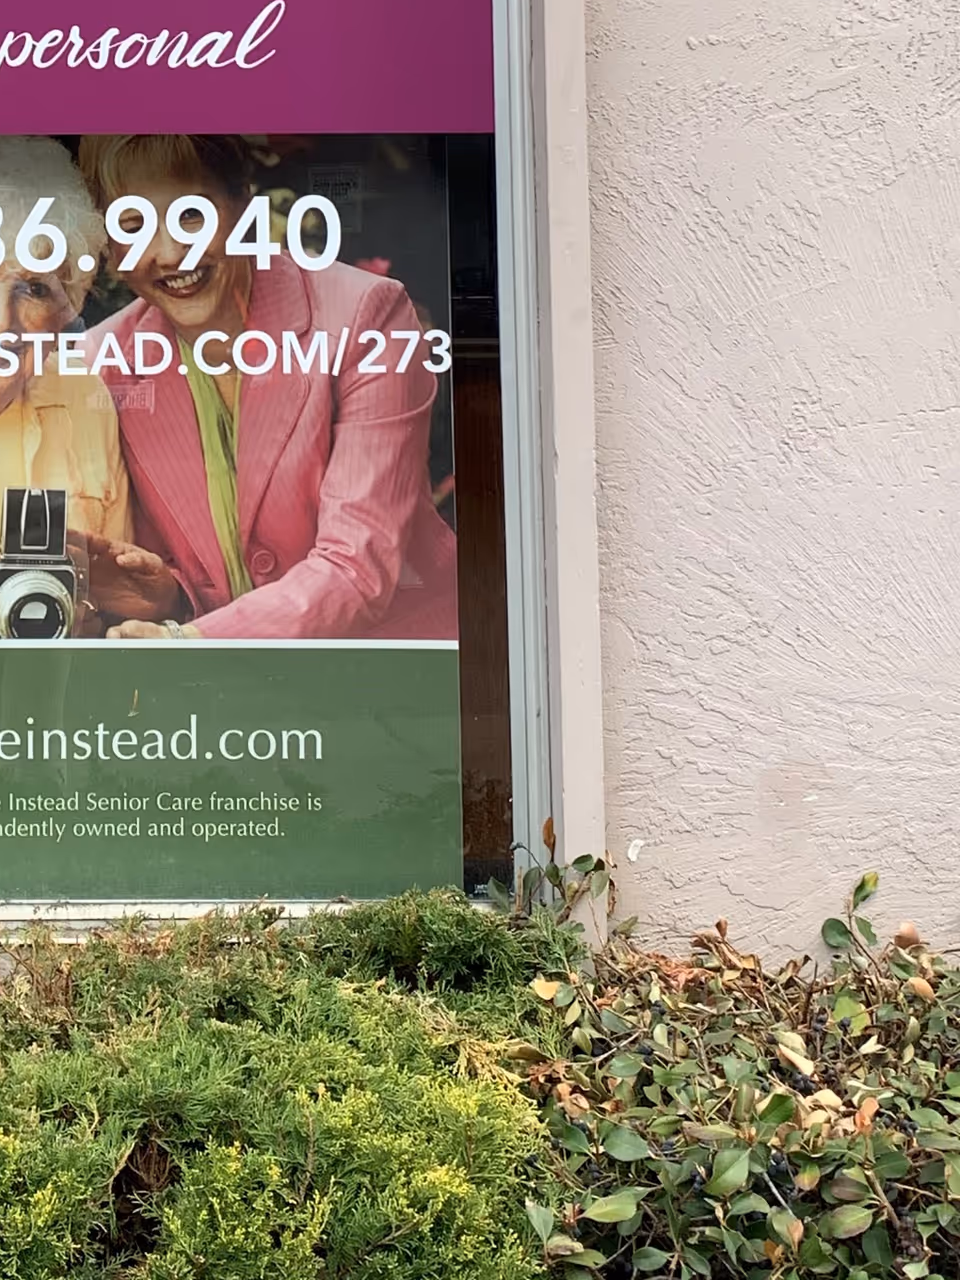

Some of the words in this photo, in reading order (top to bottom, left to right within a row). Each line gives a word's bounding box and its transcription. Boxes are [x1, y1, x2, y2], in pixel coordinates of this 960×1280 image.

[8, 792, 79, 812] Instead
[86, 792, 150, 812] Senior
[156, 792, 203, 812] Care
[209, 792, 300, 812] franchise
[307, 792, 322, 812] is
[72, 817, 141, 837] owned
[147, 817, 185, 837] and
[191, 817, 286, 842] operated.
